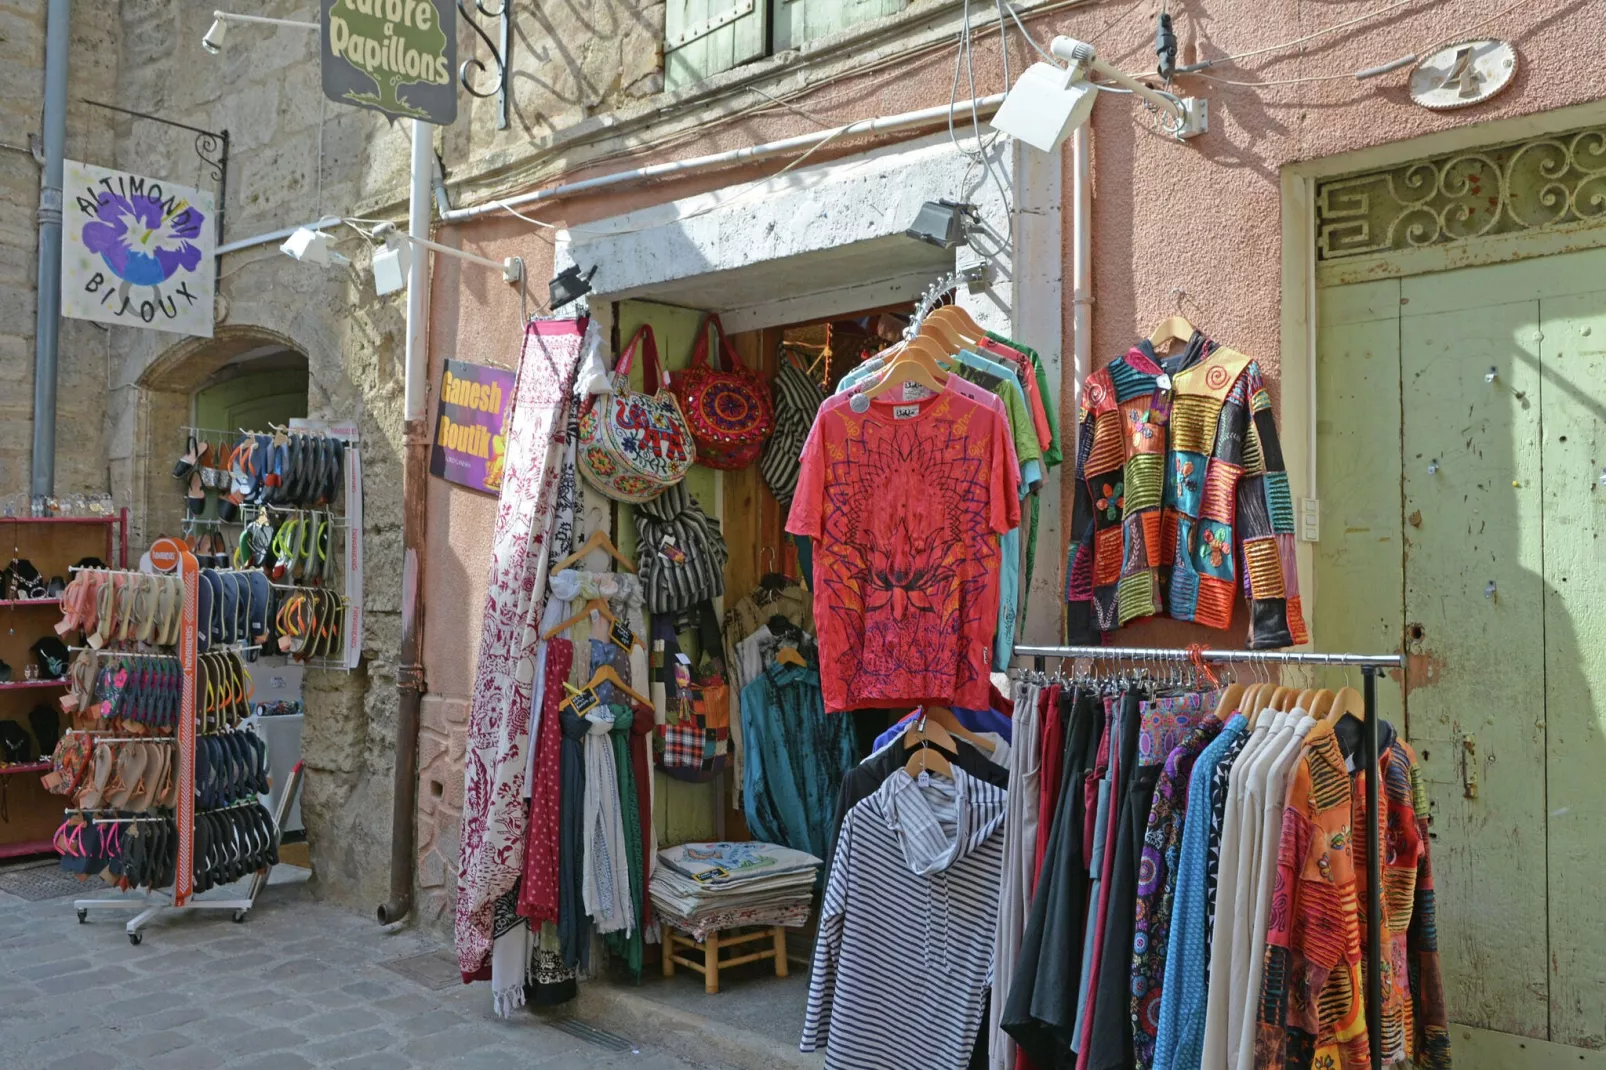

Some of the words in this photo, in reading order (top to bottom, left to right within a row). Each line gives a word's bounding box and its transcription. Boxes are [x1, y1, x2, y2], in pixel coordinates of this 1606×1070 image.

[330, 16, 450, 85] Papillons
[1440, 46, 1479, 97] 4
[76, 175, 198, 234] ALTIMONDI
[85, 272, 198, 323] BIJOUX
[441, 370, 502, 415] Ganesh
[437, 415, 493, 459] Boutik
